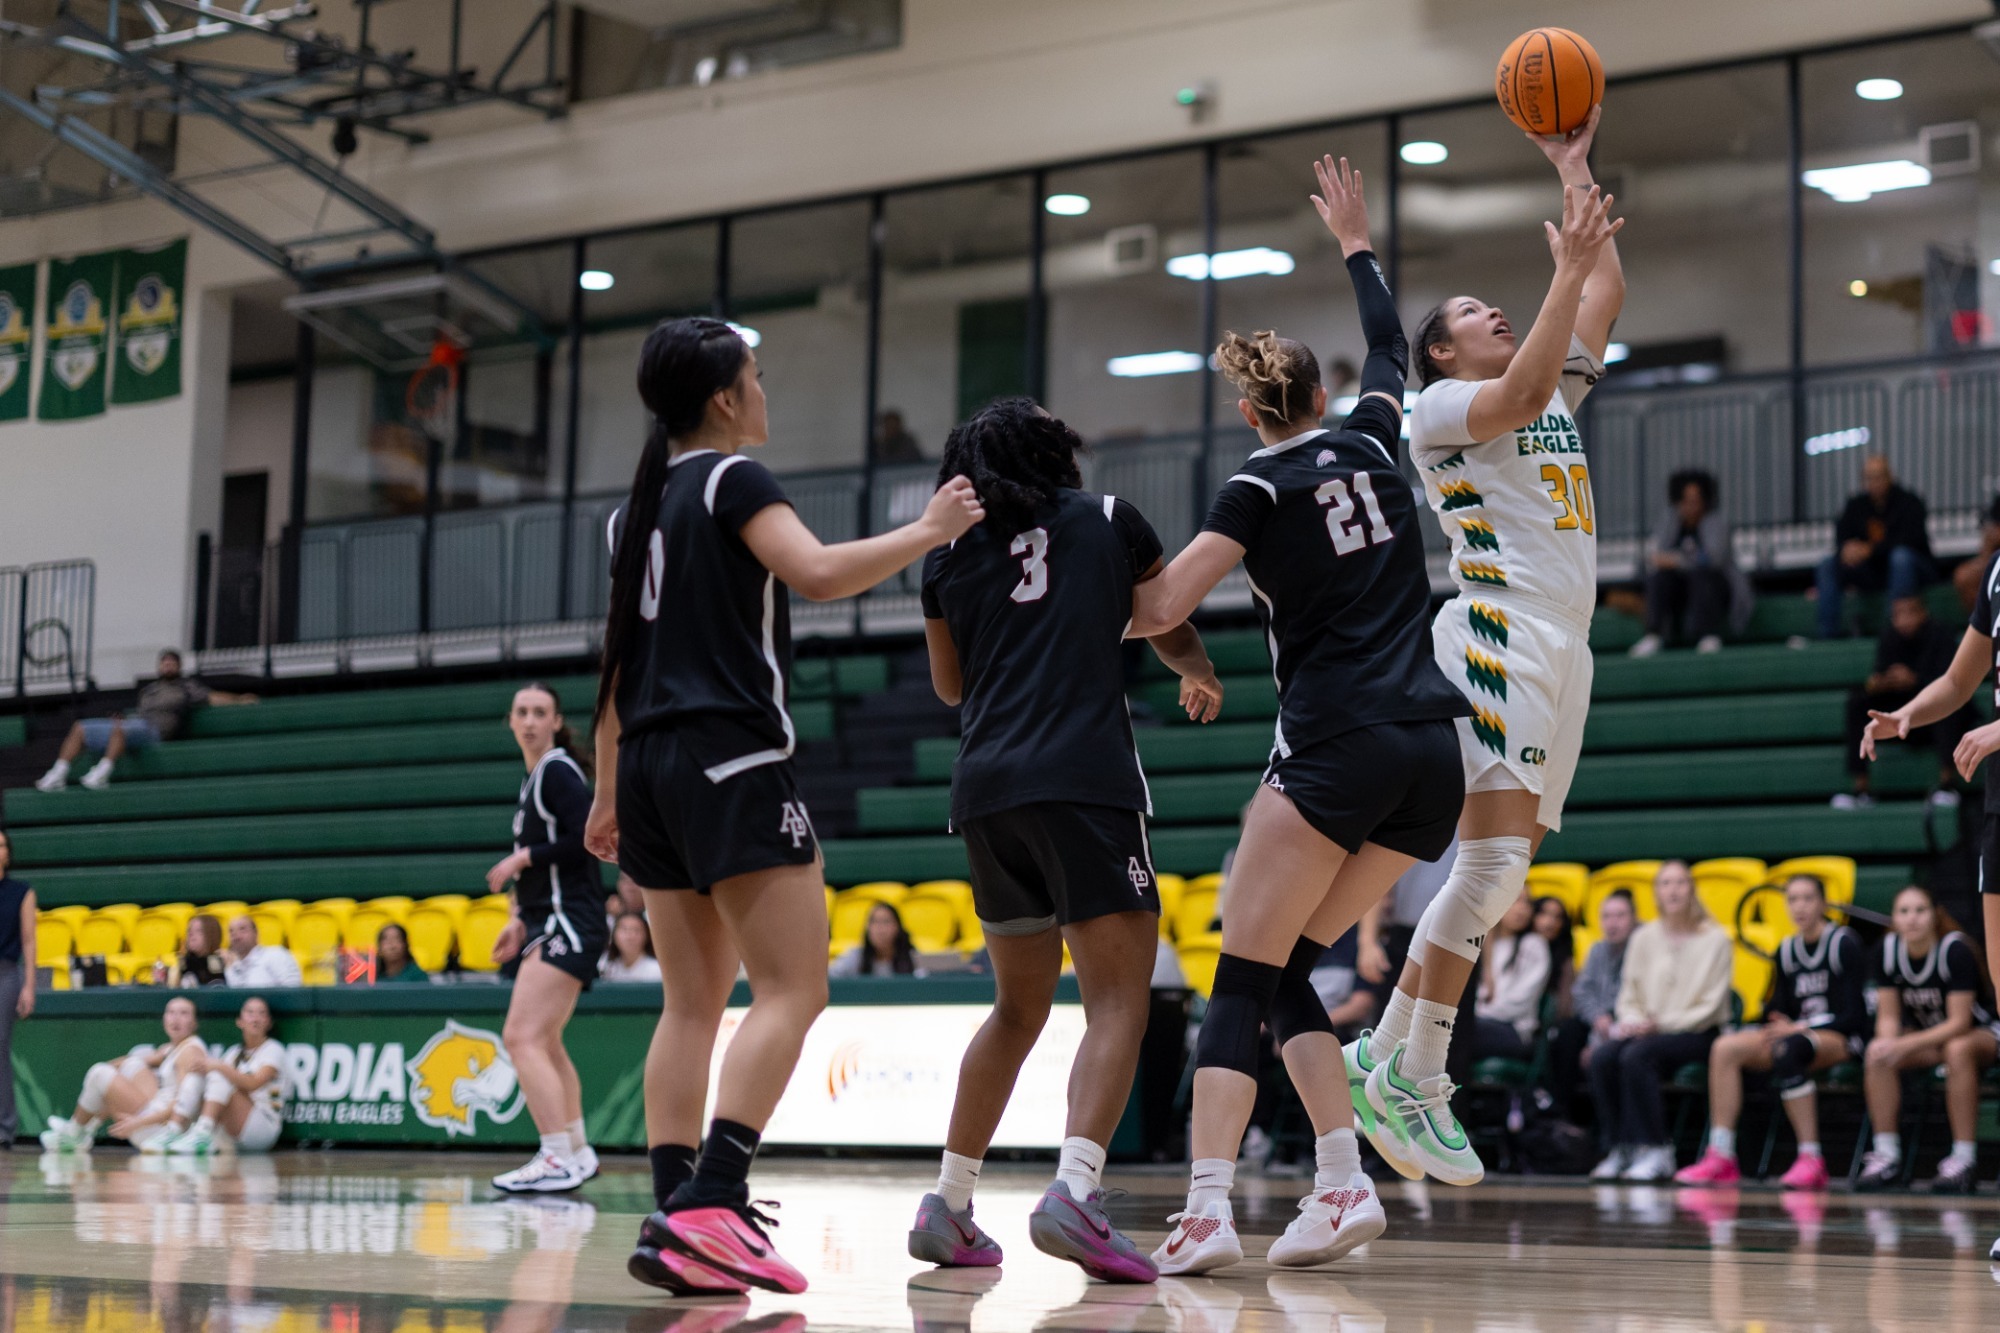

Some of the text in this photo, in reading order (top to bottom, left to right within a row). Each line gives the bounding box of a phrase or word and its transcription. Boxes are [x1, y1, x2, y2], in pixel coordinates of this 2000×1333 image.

[1313, 470, 1396, 557] 21
[1539, 463, 1594, 536] 30
[1008, 526, 1049, 604] 3
[285, 1042, 407, 1102] RDIA
[283, 1102, 405, 1126] LDEN EAGLES
